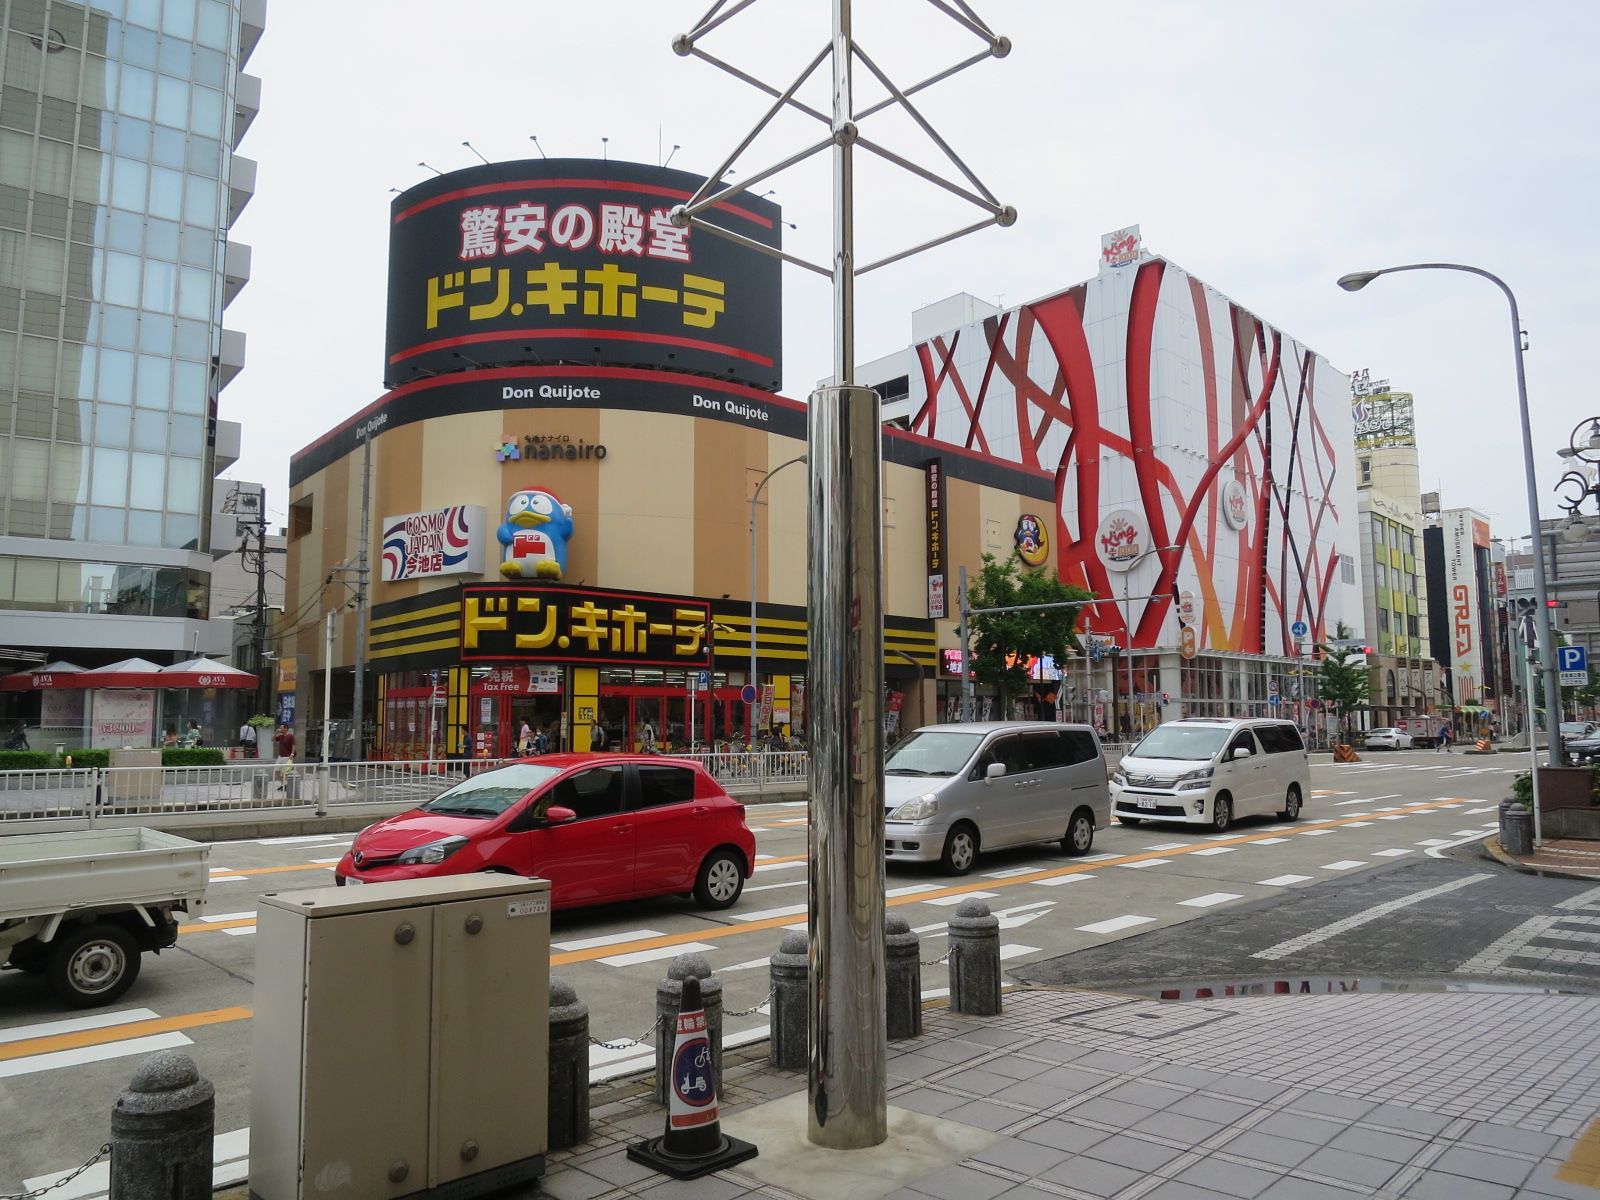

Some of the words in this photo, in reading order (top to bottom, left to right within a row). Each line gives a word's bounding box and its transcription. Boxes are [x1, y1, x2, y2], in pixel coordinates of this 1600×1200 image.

[459, 204, 691, 261] 驚安の殿堂
[502, 386, 536, 400] Don
[539, 385, 601, 400] Quijote
[692, 394, 720, 411] Don
[724, 400, 769, 421] Quijote
[524, 438, 607, 460] nanairo
[406, 512, 445, 536] COSMO
[405, 532, 444, 555] JAPAN
[1101, 525, 1138, 554] King
[406, 553, 442, 574] 今池店
[1565, 649, 1580, 669] P
[488, 670, 513, 682] 免税
[700, 673, 706, 682] P
[483, 683, 499, 691] Tax
[500, 683, 520, 691] Free
